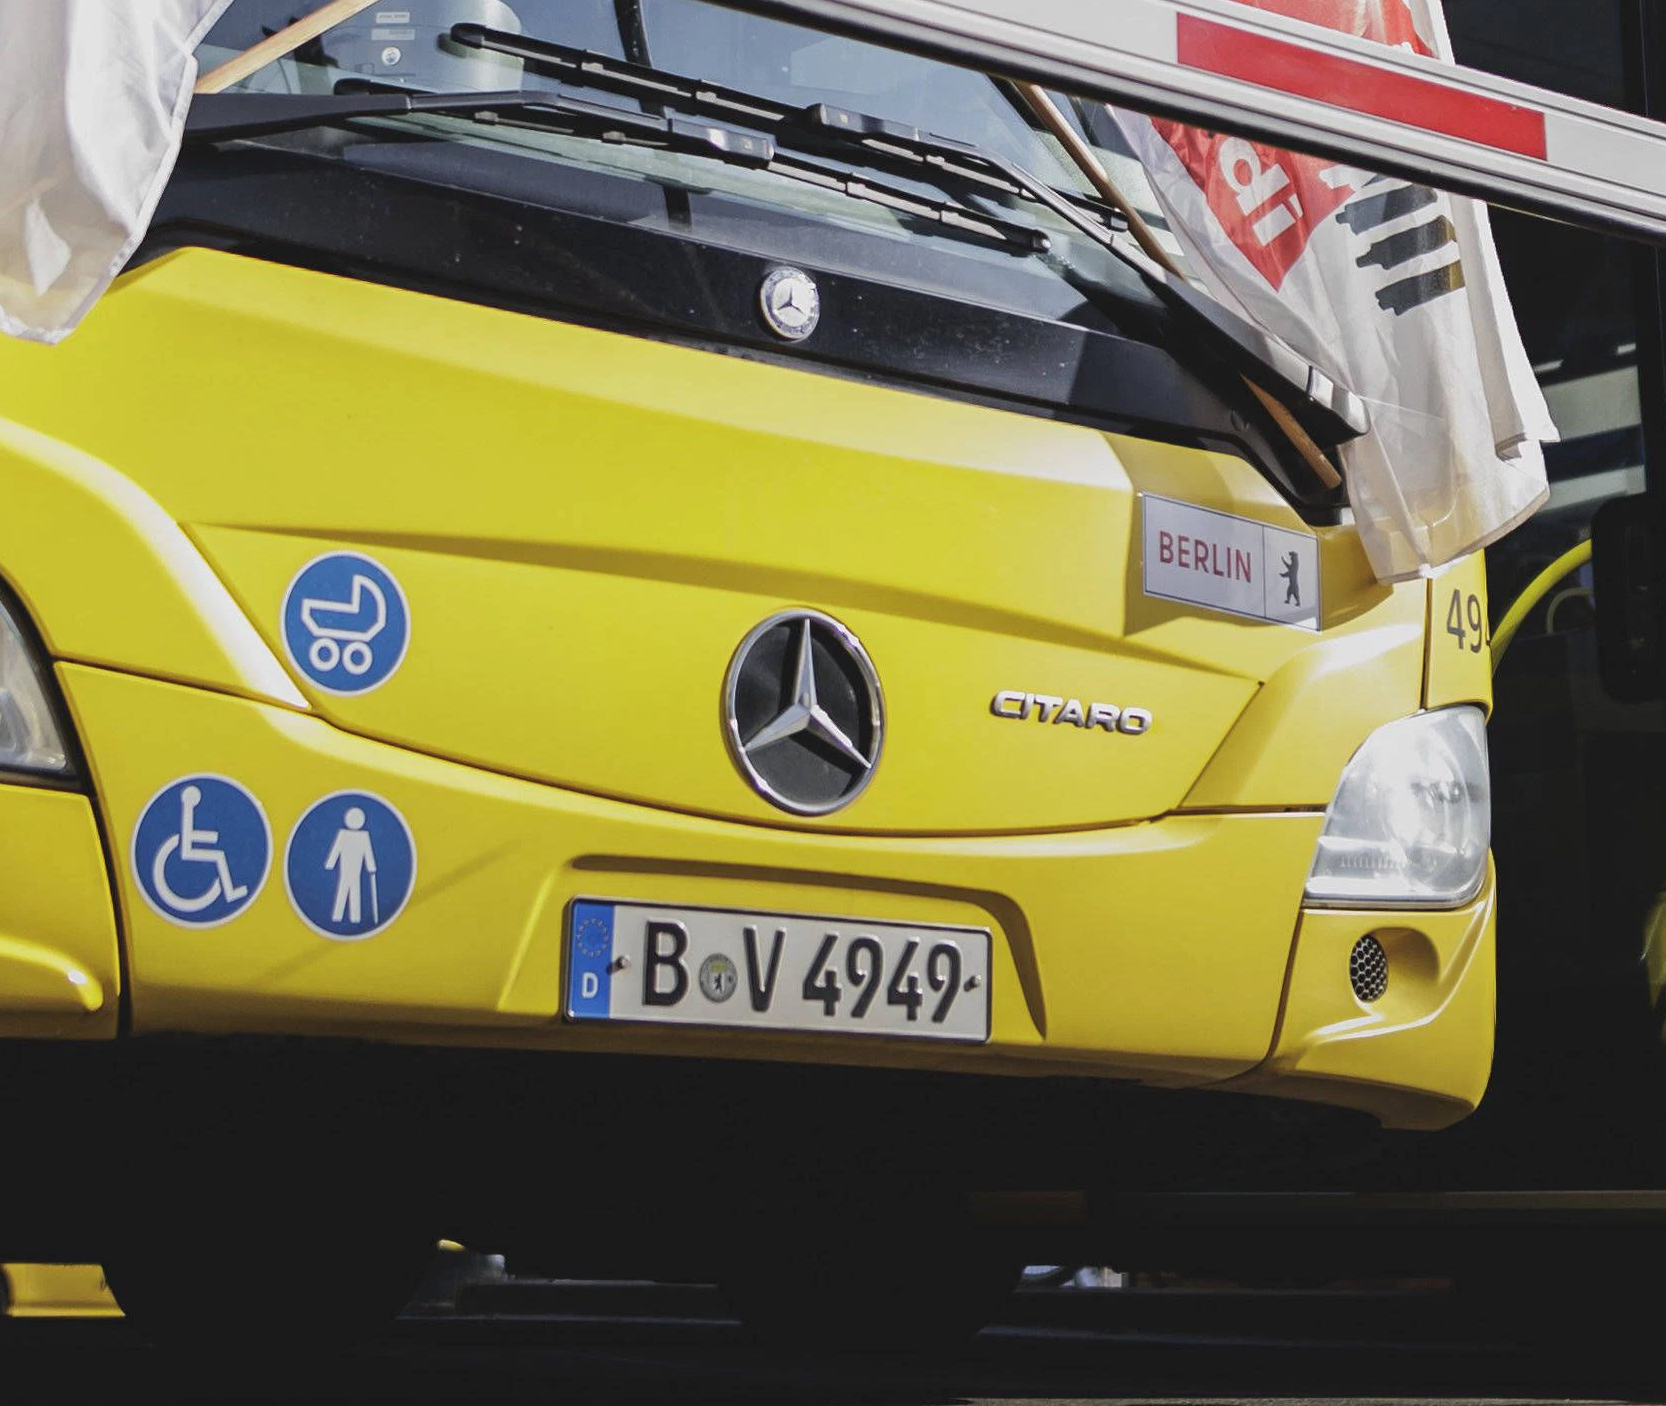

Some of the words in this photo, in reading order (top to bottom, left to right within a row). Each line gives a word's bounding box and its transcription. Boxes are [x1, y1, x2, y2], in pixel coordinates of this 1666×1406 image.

[1159, 530, 1252, 583] BERLIN
[990, 689, 1152, 735] CITARO
[581, 972, 598, 999] D
[642, 919, 690, 1007] B
[743, 925, 787, 1012] V
[802, 932, 963, 1023] 4949
